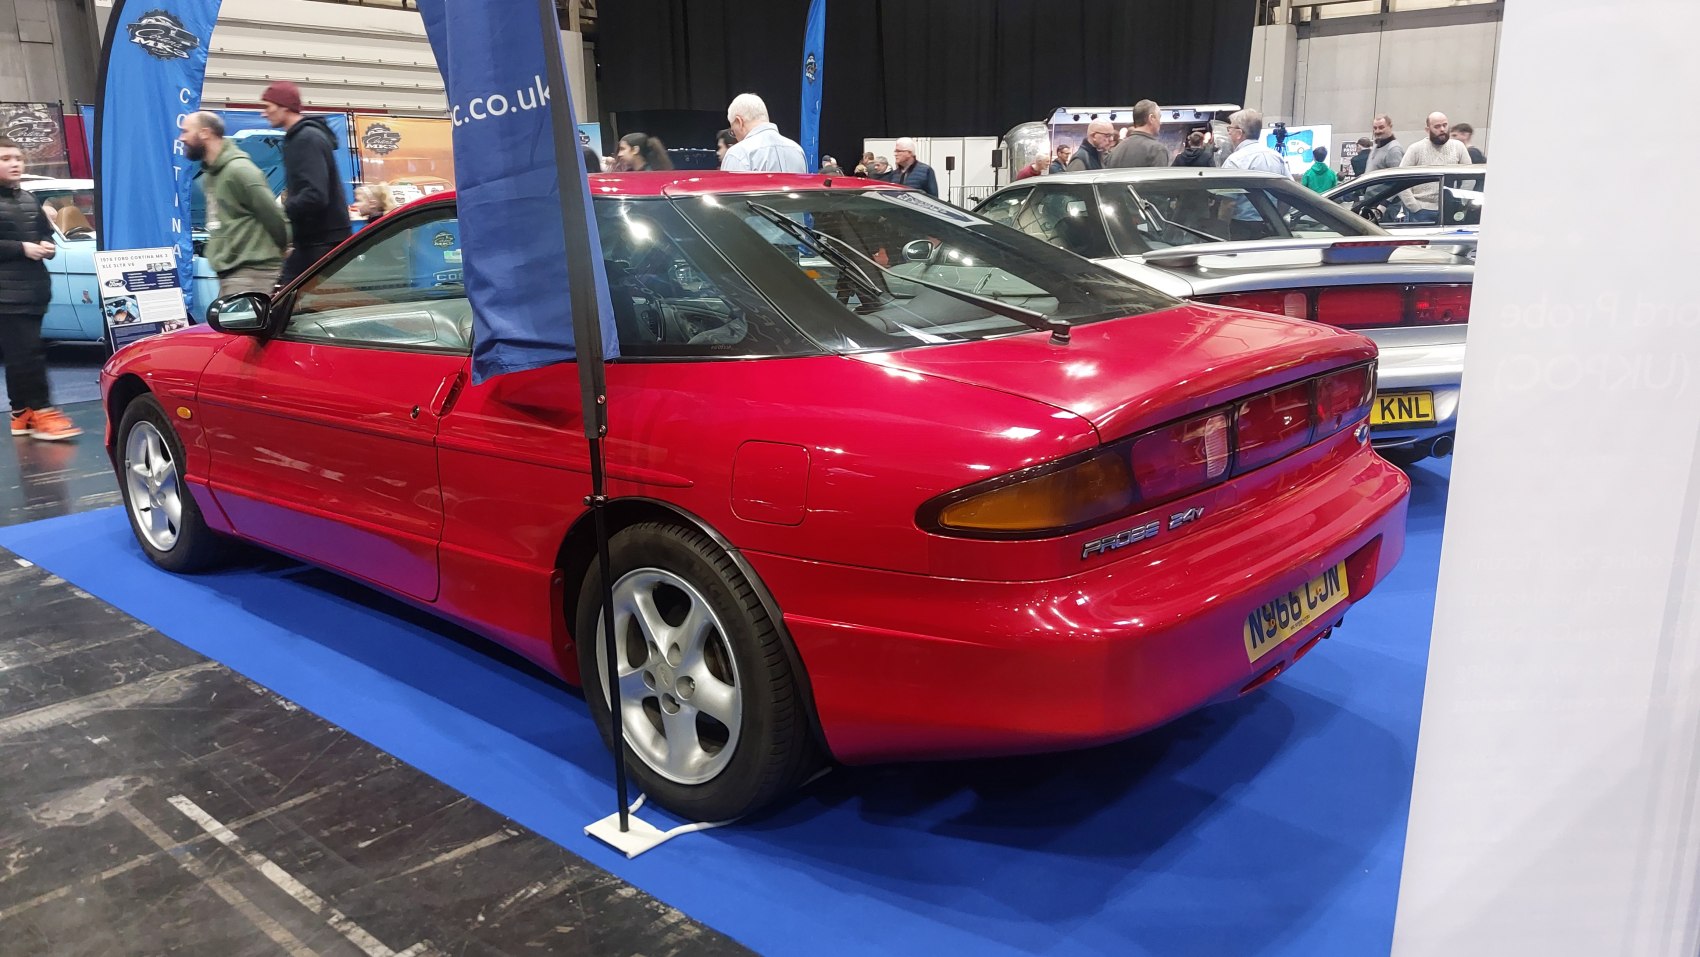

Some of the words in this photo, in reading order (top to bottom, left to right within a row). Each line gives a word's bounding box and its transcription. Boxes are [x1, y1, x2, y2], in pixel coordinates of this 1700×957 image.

[450, 74, 550, 128] c.co.uk
[1380, 396, 1430, 421] KNL
[1081, 520, 1161, 560] PROBE
[1248, 591, 1302, 650] N966
